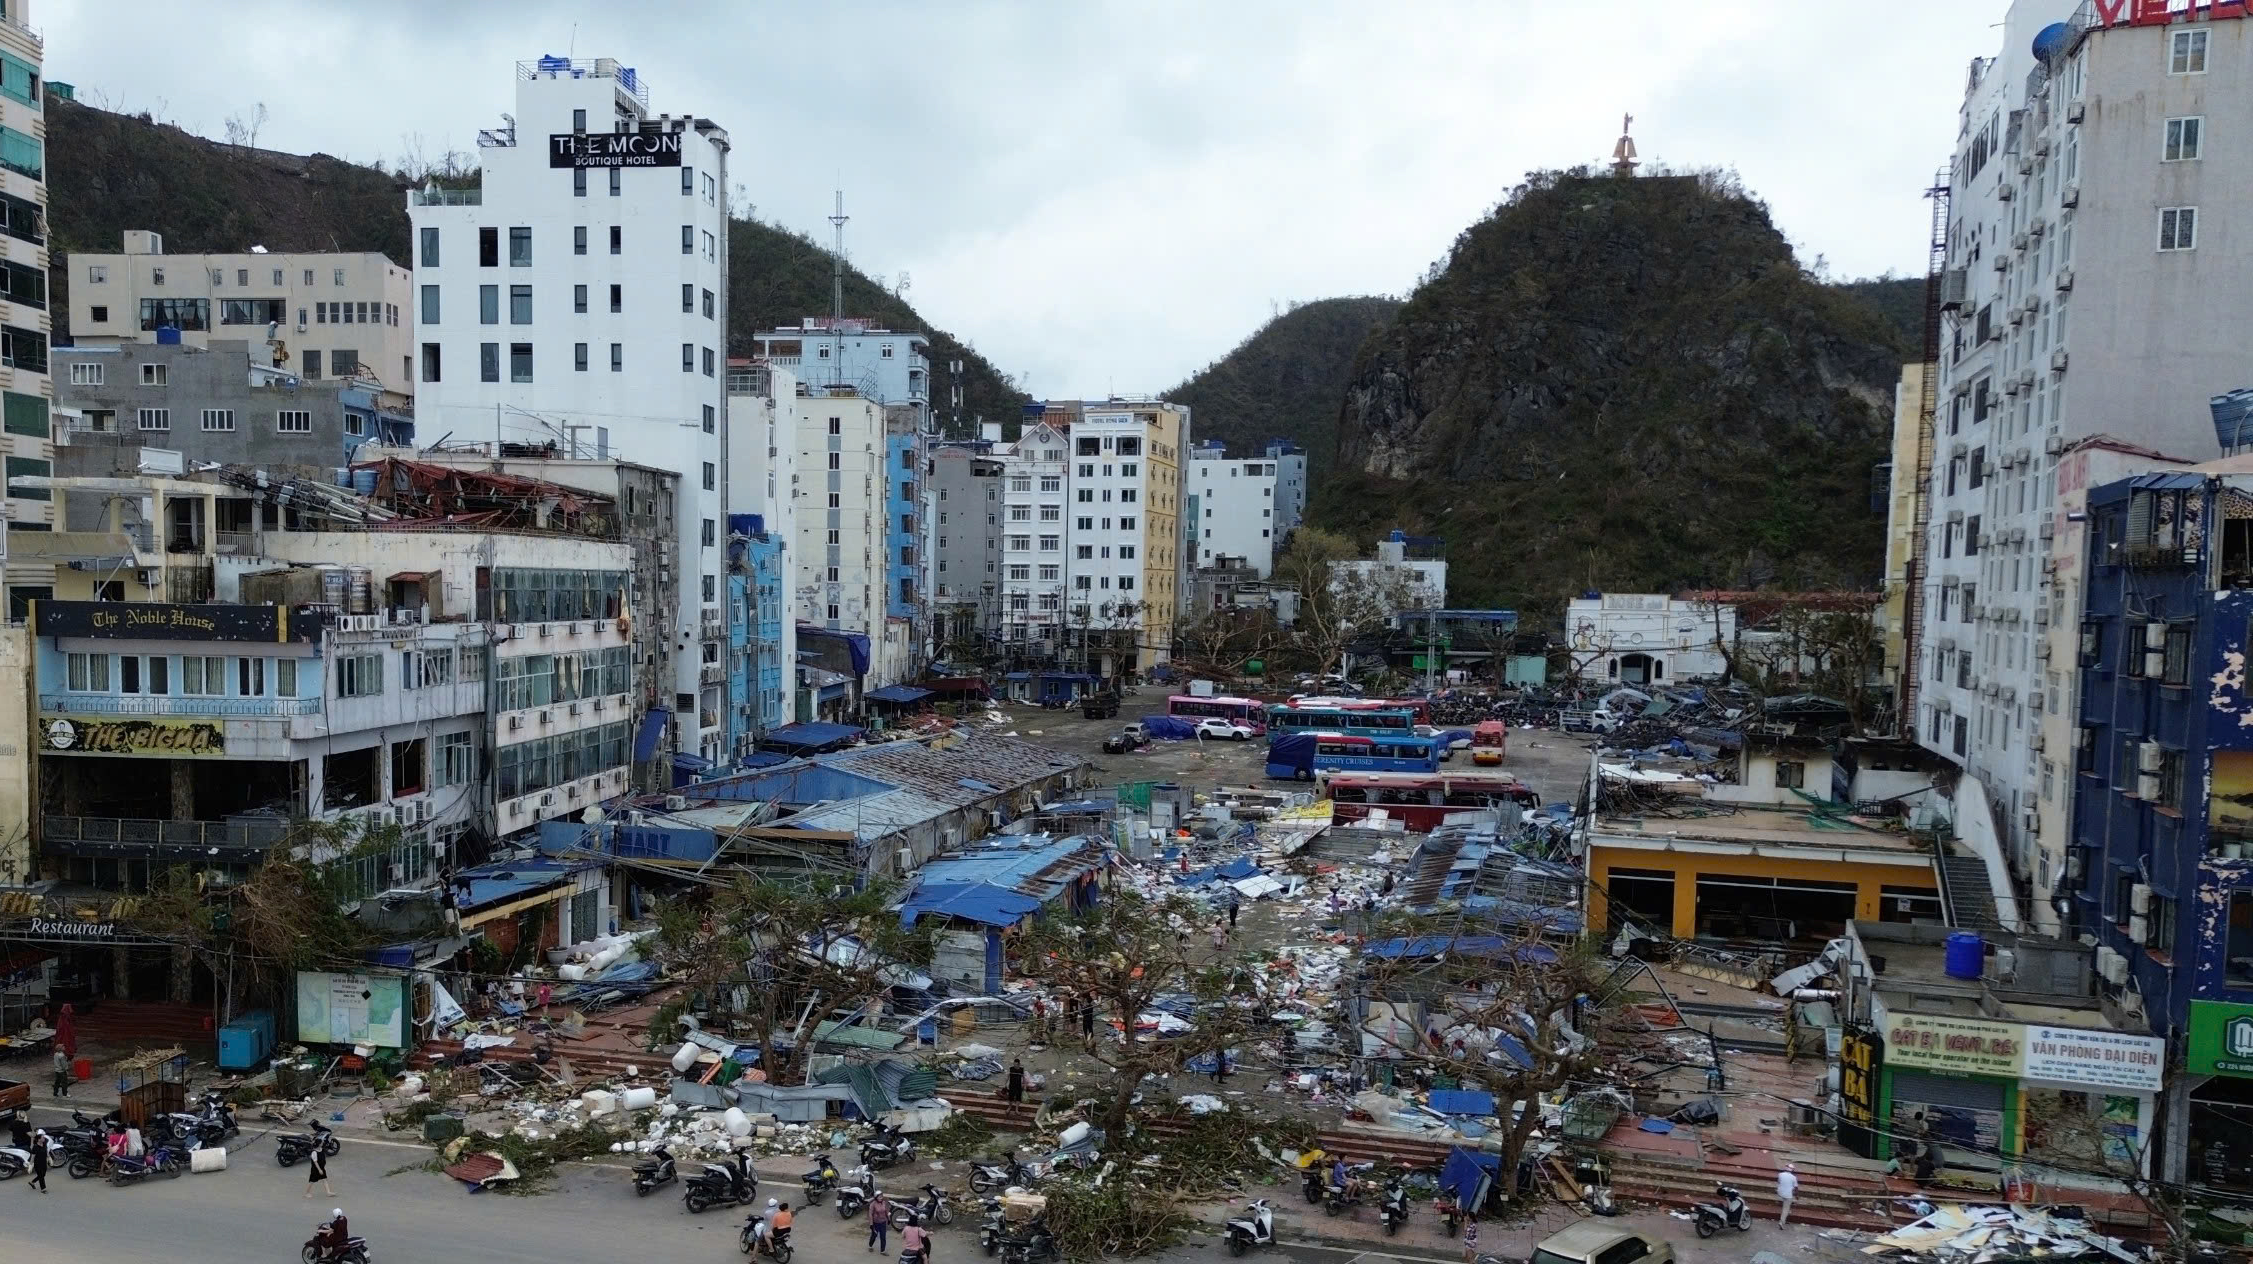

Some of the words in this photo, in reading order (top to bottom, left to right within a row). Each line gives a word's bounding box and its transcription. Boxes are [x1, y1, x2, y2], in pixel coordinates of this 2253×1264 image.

[608, 135, 678, 154] MOON
[575, 156, 623, 166] BOUTIQUE
[626, 155, 656, 165] HOTEL
[92, 610, 119, 629] The
[125, 608, 167, 629] Noble
[169, 609, 216, 632] House
[83, 724, 124, 749] THE
[1312, 756, 1344, 766] SERENITY
[1345, 757, 1374, 766] CRUISES
[30, 917, 115, 936] Restaurant
[1890, 1028, 1918, 1047] CAT
[2032, 1040, 2056, 1056] VĂN
[2060, 1042, 2101, 1060] PHÒNG
[2105, 1048, 2126, 1065] ĐẠI
[2129, 1050, 2158, 1067] DIỆN
